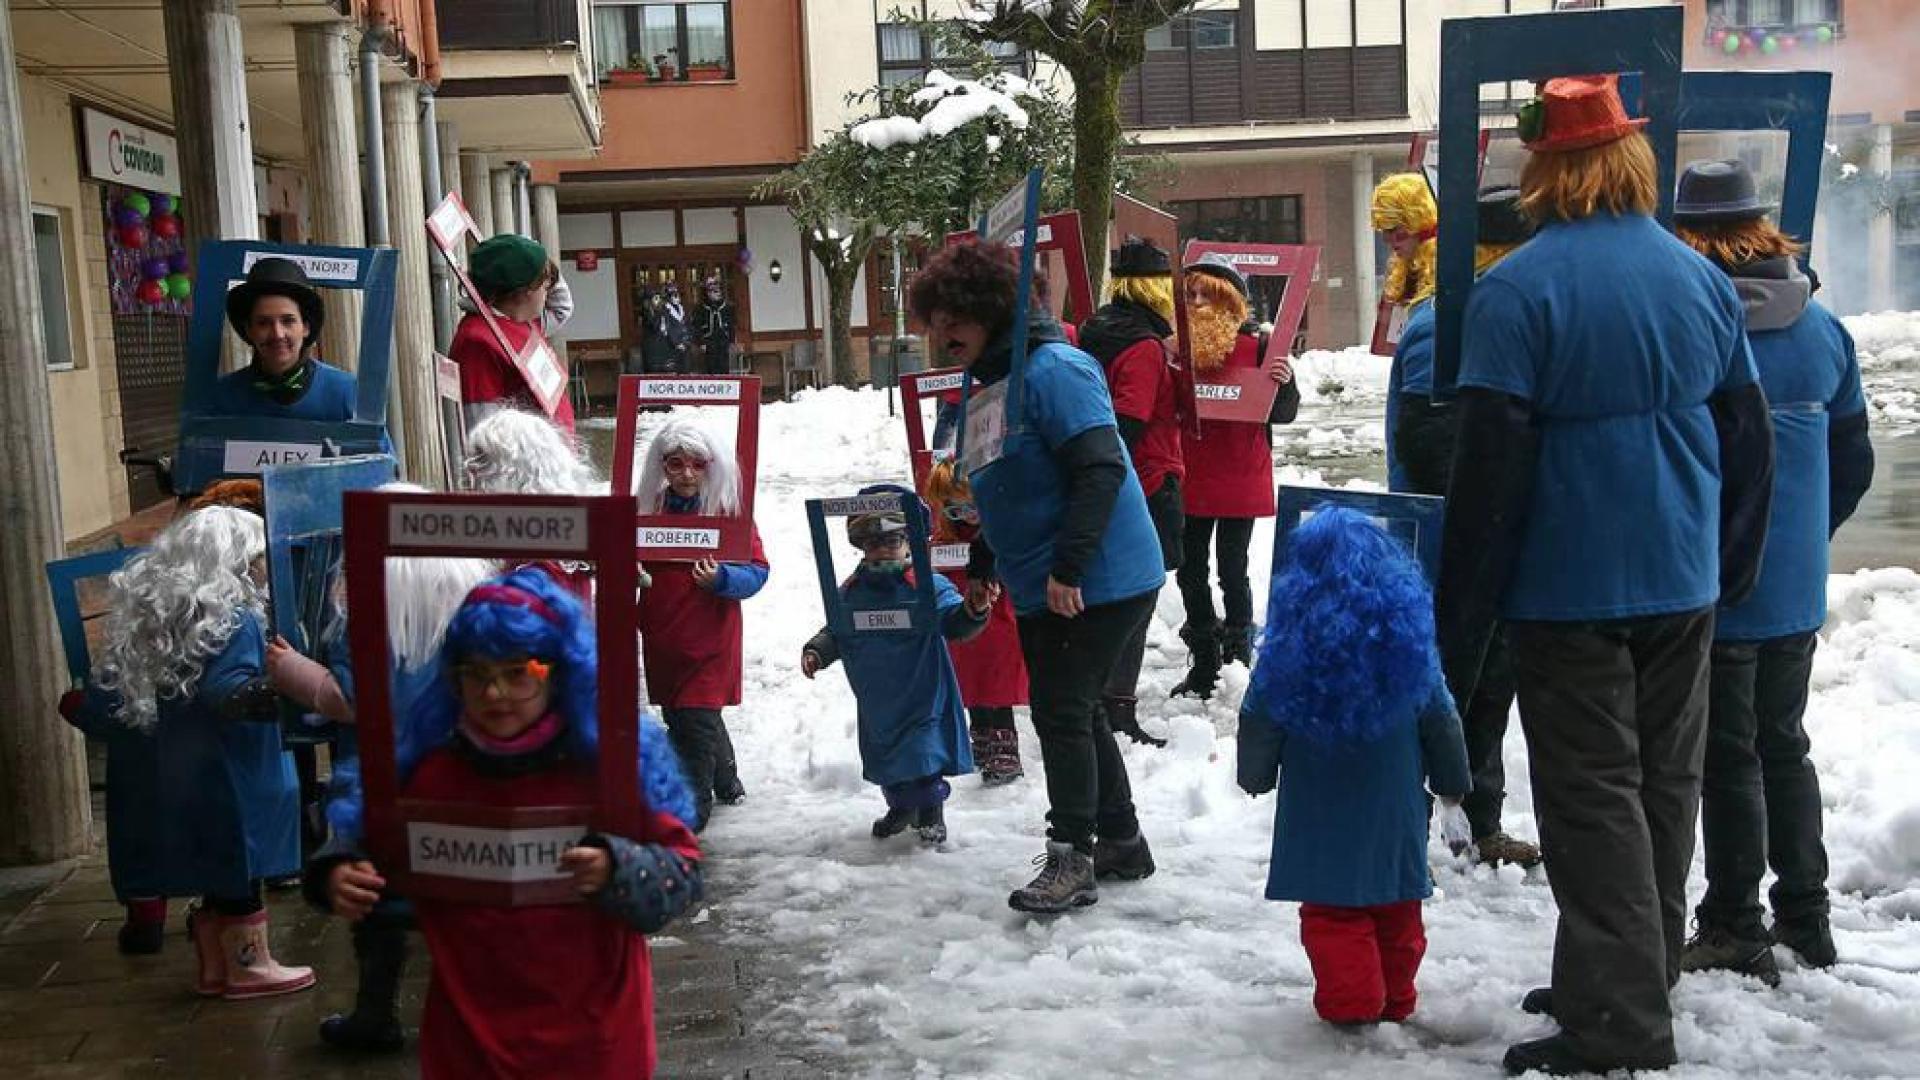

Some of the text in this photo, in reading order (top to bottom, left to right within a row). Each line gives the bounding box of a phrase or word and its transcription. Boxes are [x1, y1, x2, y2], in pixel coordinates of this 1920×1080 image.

[311, 261, 349, 273] NOR?
[648, 383, 732, 395] NOR DA NOR?
[1196, 385, 1238, 398] ARLES
[823, 501, 849, 513] NOR
[850, 500, 867, 512] DA
[402, 512, 575, 540] NOR DA NOR?
[645, 531, 711, 544] ROBERTA
[936, 547, 967, 559] PHILL
[868, 614, 896, 626] ERIK
